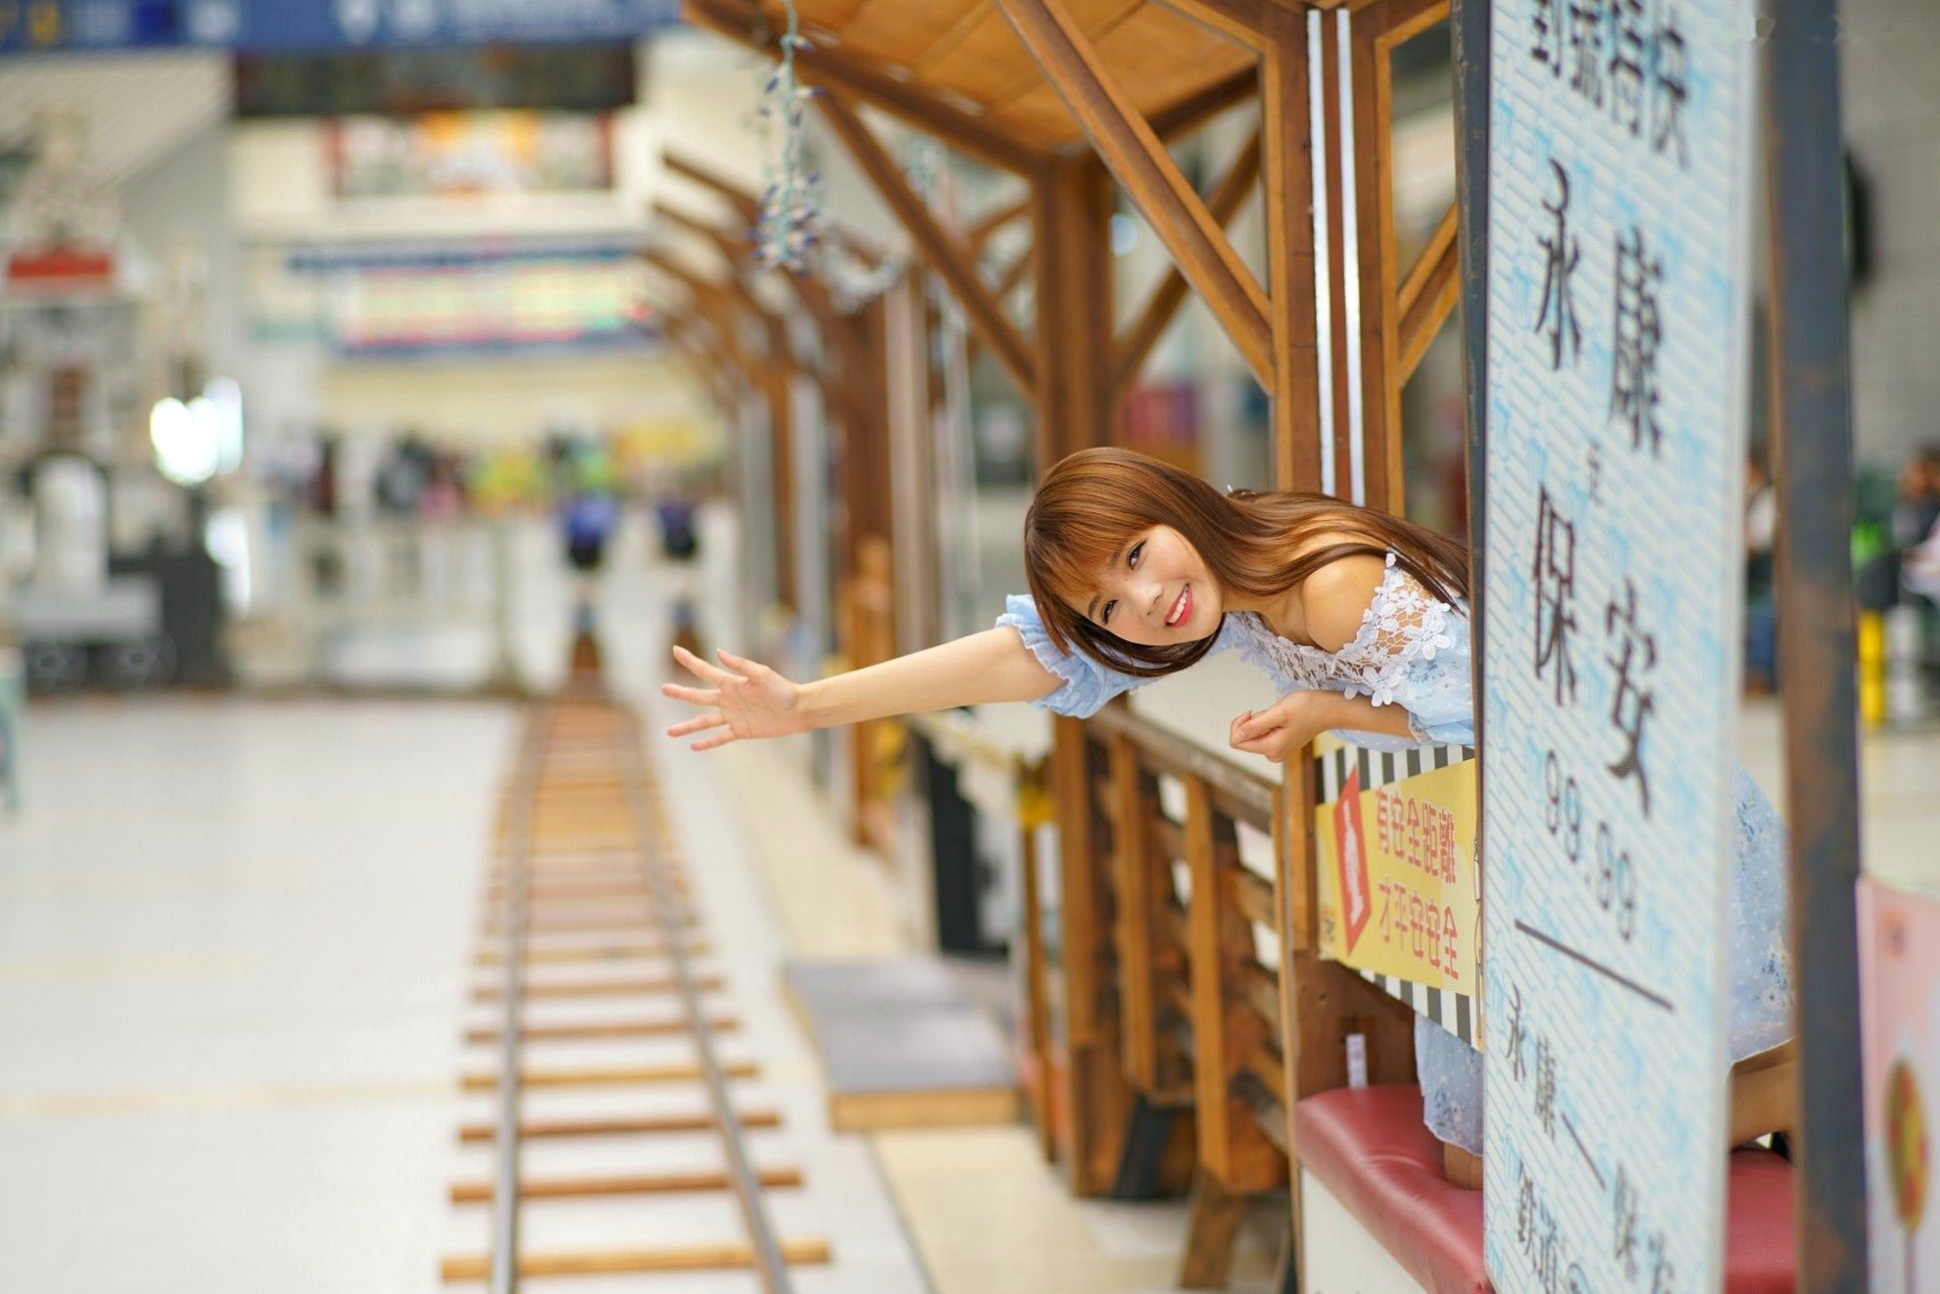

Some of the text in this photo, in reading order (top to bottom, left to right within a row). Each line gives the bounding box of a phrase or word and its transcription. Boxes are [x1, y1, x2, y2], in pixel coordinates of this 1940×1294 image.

[1535, 157, 1662, 457] 永康
[1532, 482, 1657, 821] 保安
[1375, 785, 1457, 884] 有安全距離
